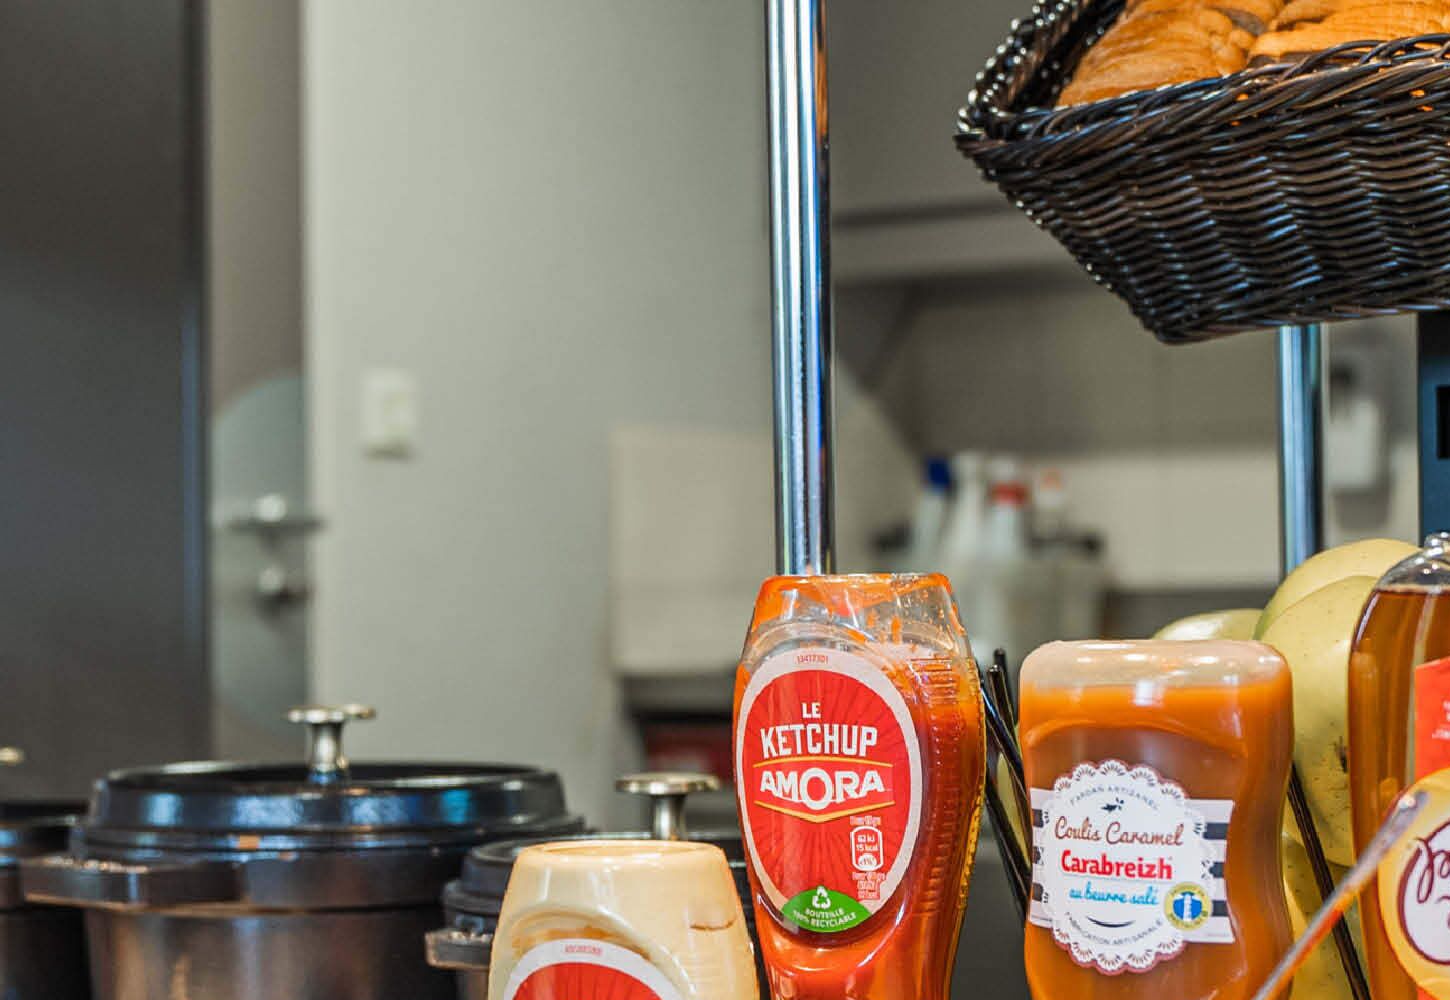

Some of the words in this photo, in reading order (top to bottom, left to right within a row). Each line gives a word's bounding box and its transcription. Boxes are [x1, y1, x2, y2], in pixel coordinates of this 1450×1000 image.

[802, 702, 821, 719] LE
[760, 724, 878, 758] KETCHUP
[759, 767, 886, 811] AMORA
[1054, 815, 1102, 841] Coulis
[1105, 821, 1185, 846] Caramel
[1061, 849, 1173, 880] Carabreizh
[1069, 887, 1086, 899] au
[1085, 880, 1128, 905] beurre
[1129, 885, 1160, 906] salé
